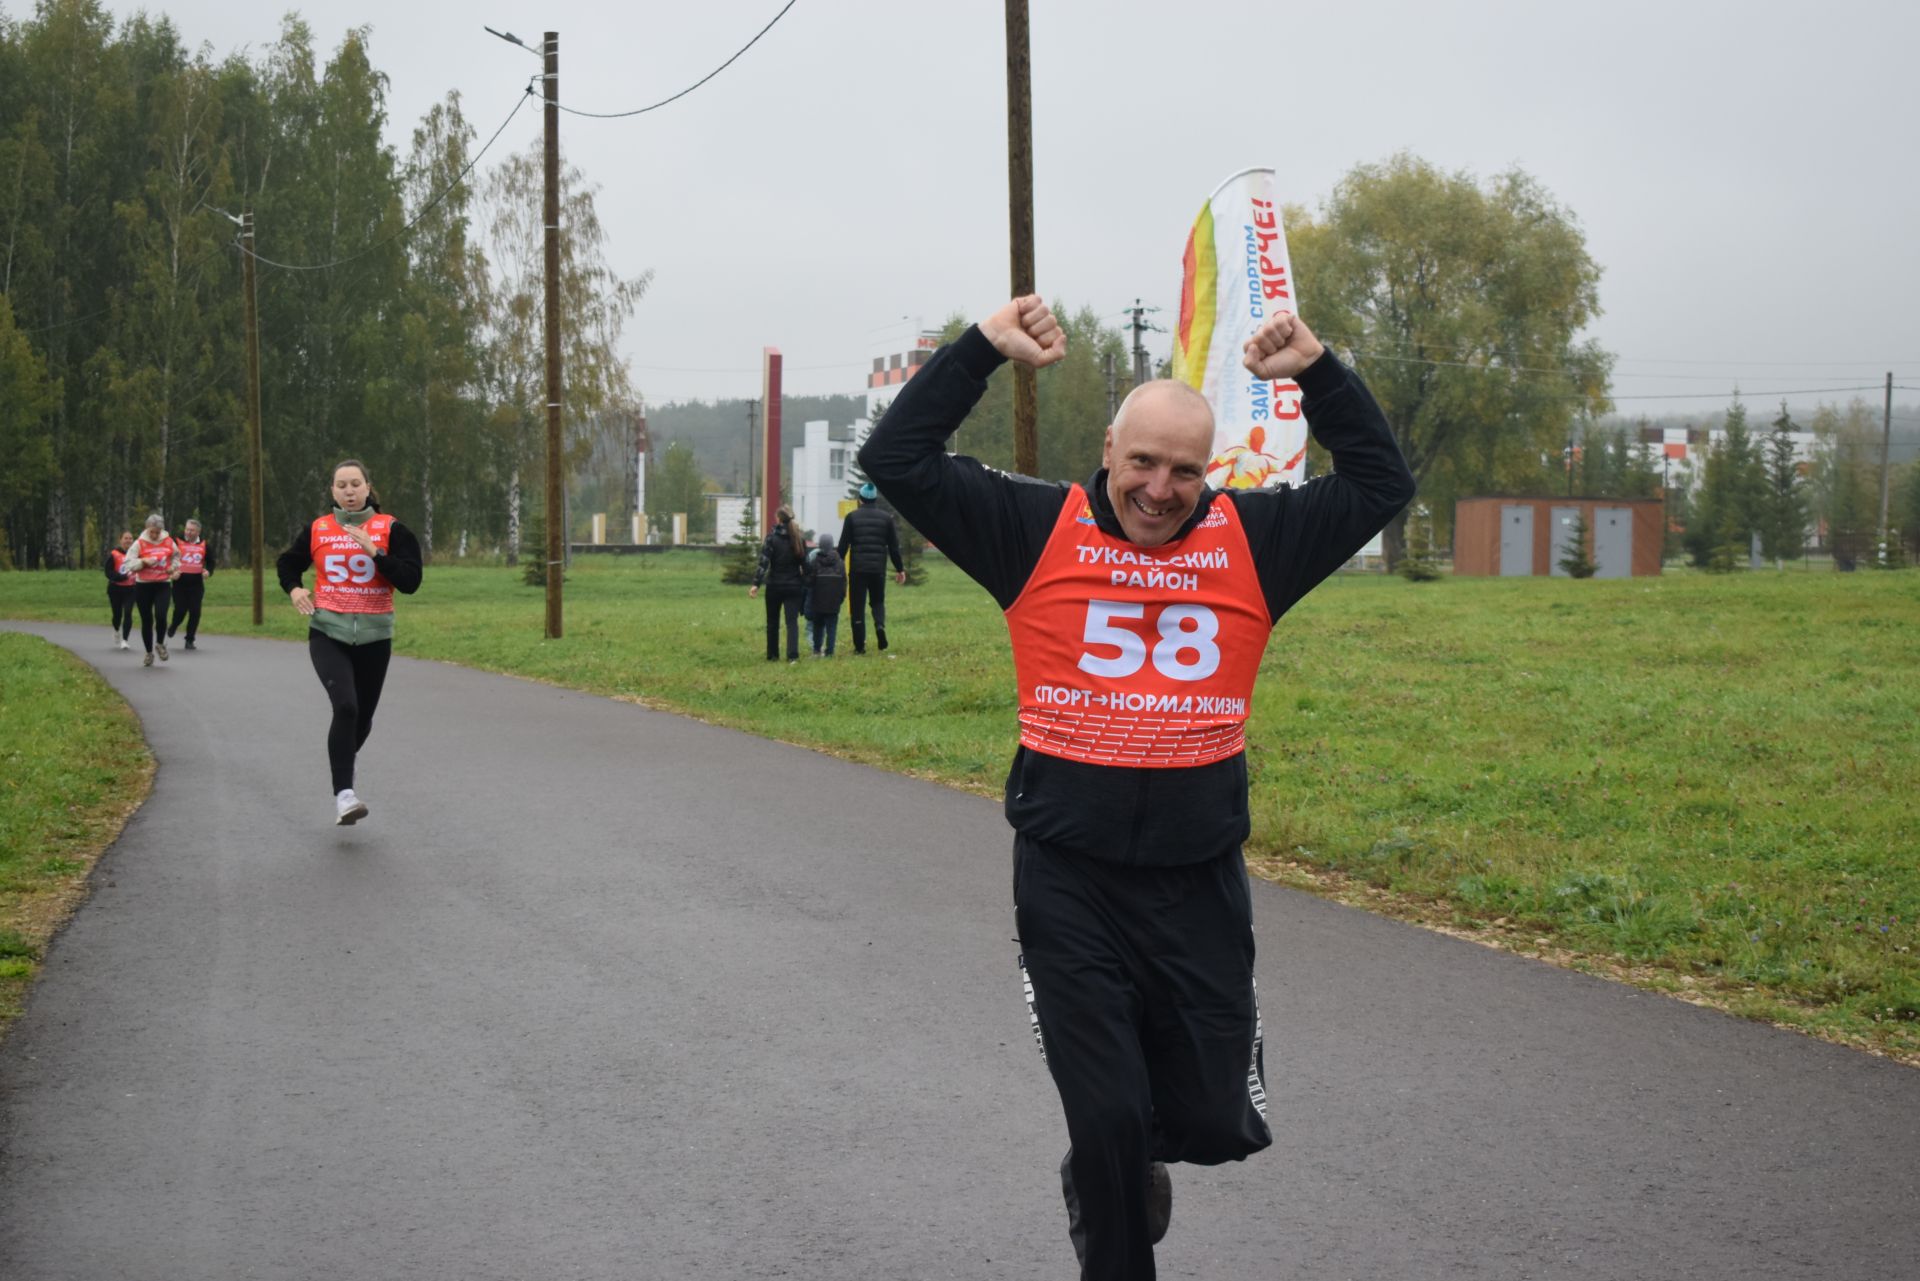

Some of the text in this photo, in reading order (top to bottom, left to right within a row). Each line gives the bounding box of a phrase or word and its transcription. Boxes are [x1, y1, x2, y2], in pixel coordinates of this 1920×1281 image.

[1251, 198, 1289, 300] ЯРЧЕ!
[1244, 225, 1263, 319] СПОРТОМ
[332, 542, 362, 550] РАЙО
[325, 554, 375, 584] 59
[1111, 567, 1198, 591] РАЙОН
[1077, 598, 1221, 682] 58
[1110, 692, 1191, 714] НОРМА
